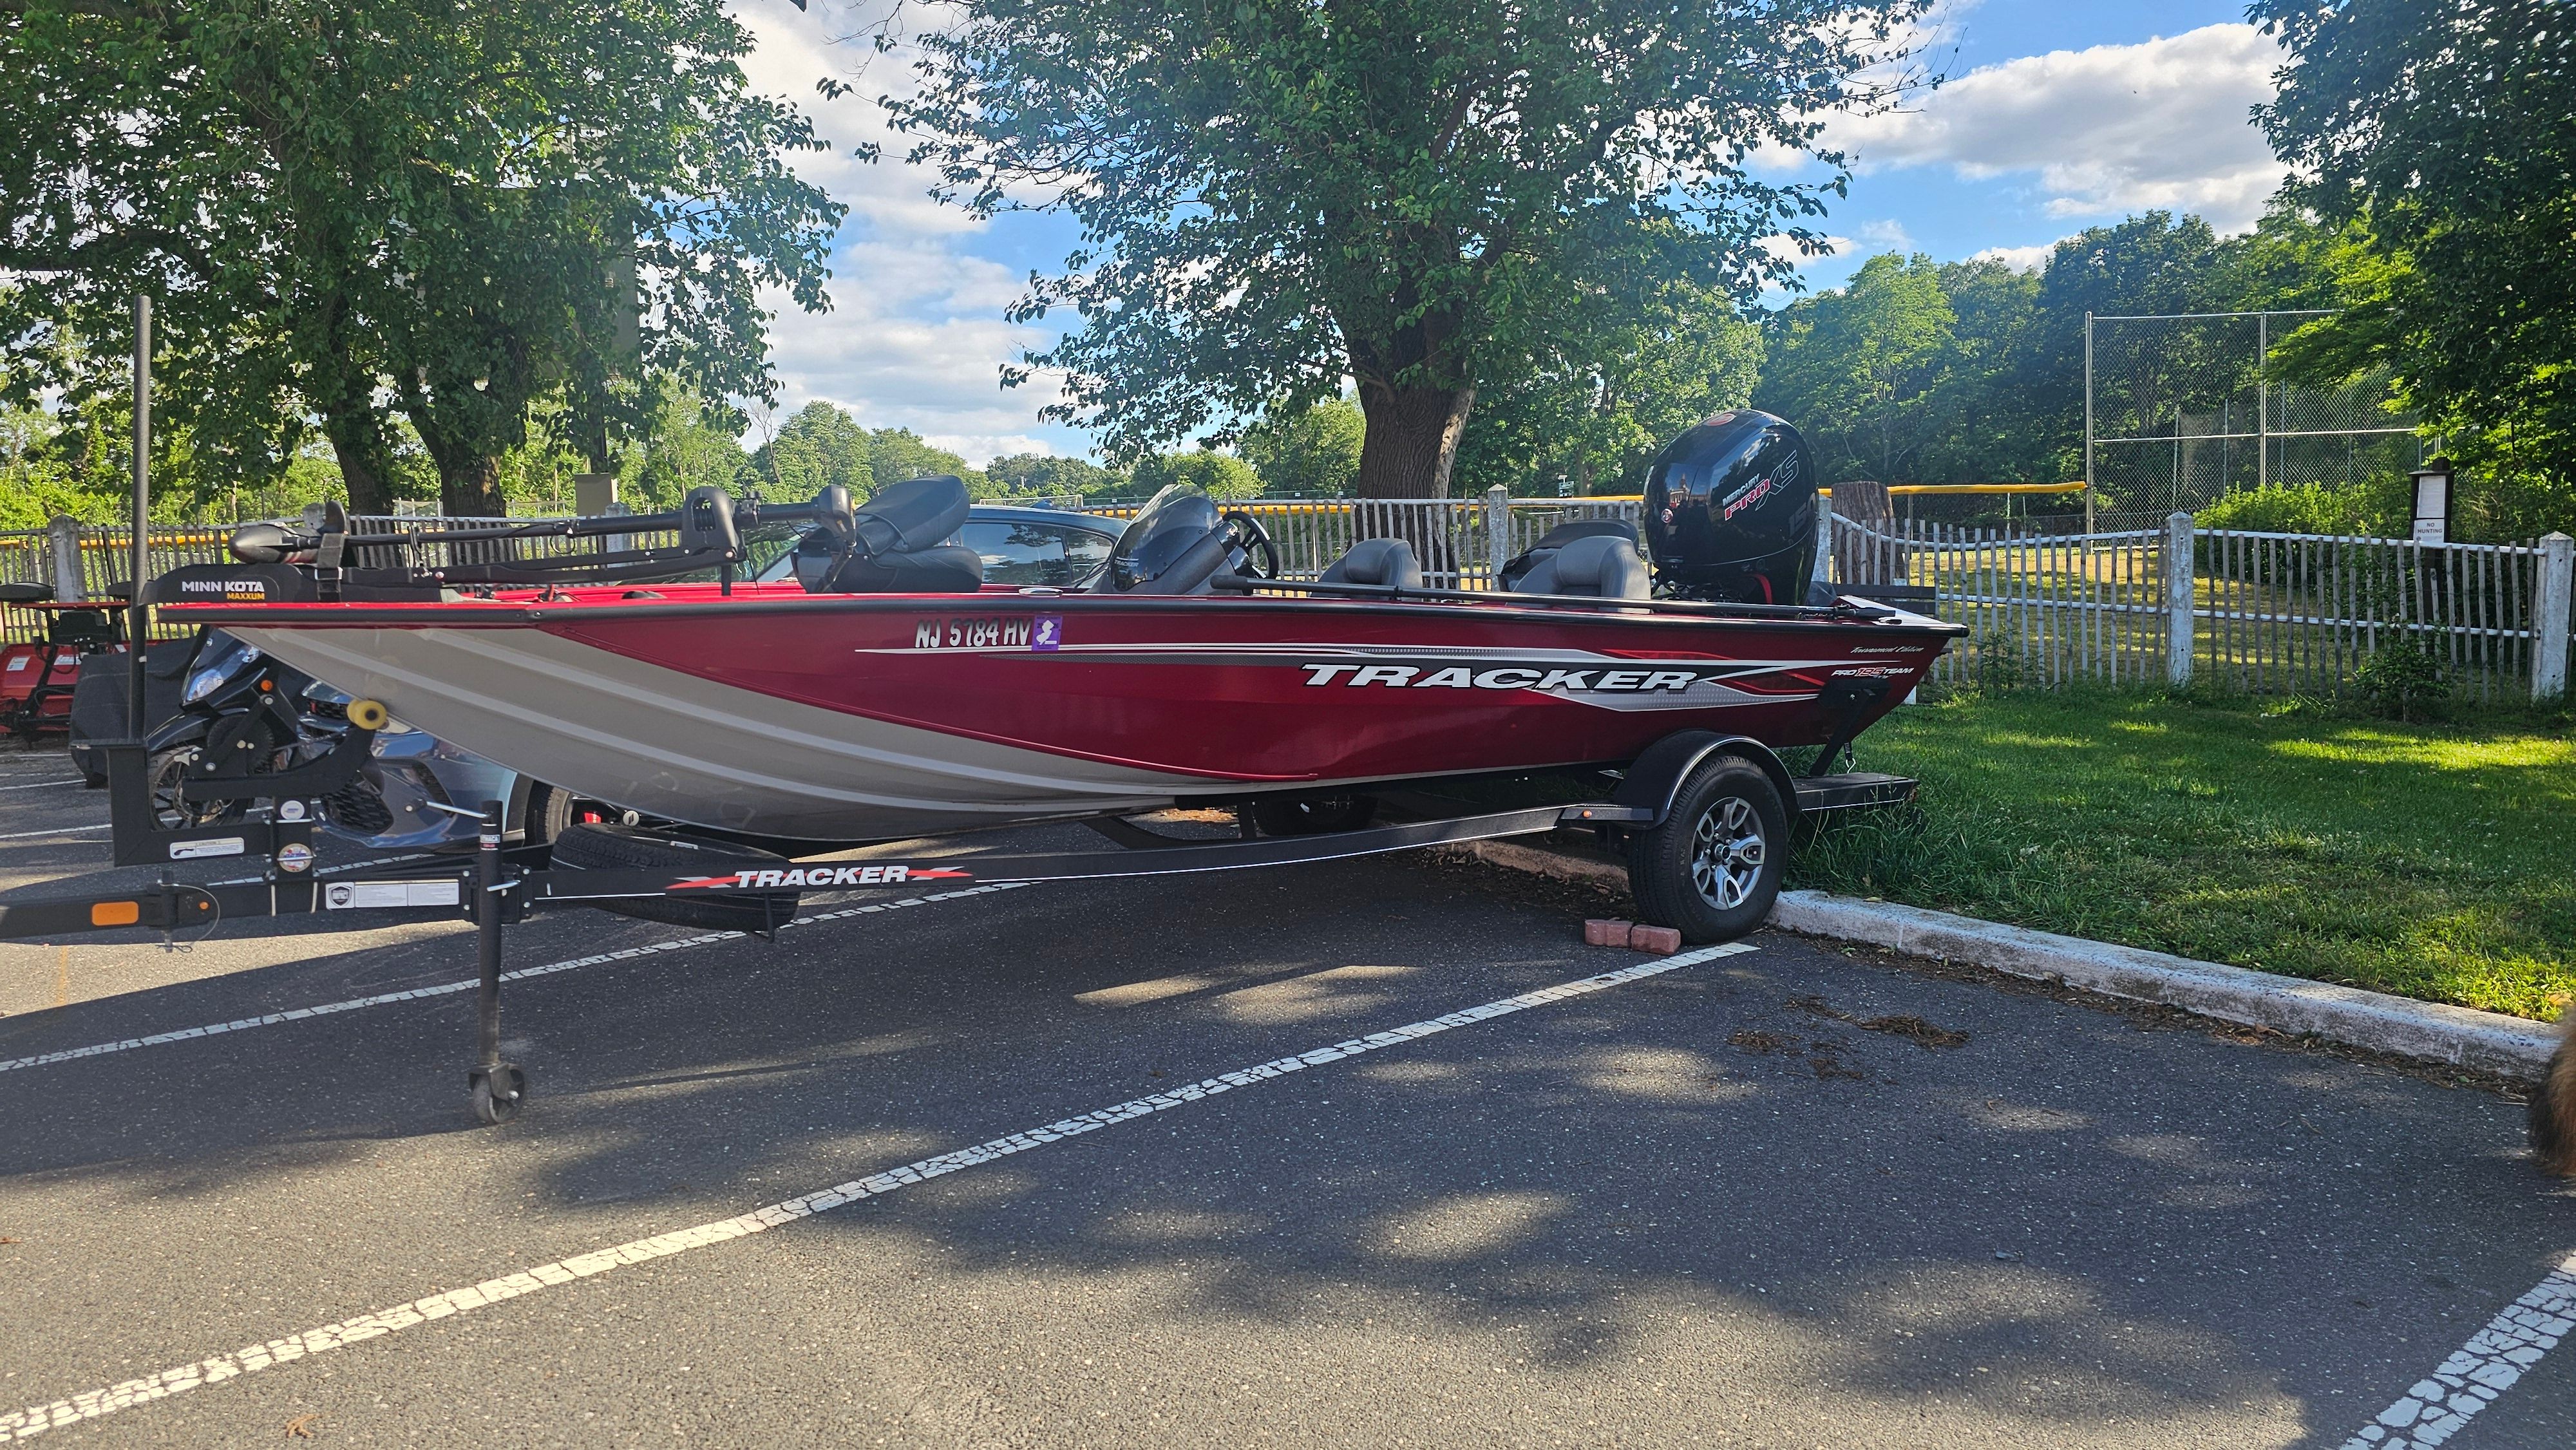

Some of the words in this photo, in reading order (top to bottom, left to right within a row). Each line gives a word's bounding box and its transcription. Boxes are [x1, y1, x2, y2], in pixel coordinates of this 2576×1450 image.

[1722, 473, 1760, 507] MERCURY
[1725, 478, 1770, 521] PRO
[1788, 492, 1817, 537] 150
[182, 581, 222, 592] MINN
[225, 581, 265, 592] KOTA
[915, 618, 942, 648] NJ
[949, 617, 999, 647] 5784
[1003, 617, 1032, 646] HV
[1302, 664, 1698, 690] TRACKER
[735, 865, 909, 888] TRACKER
